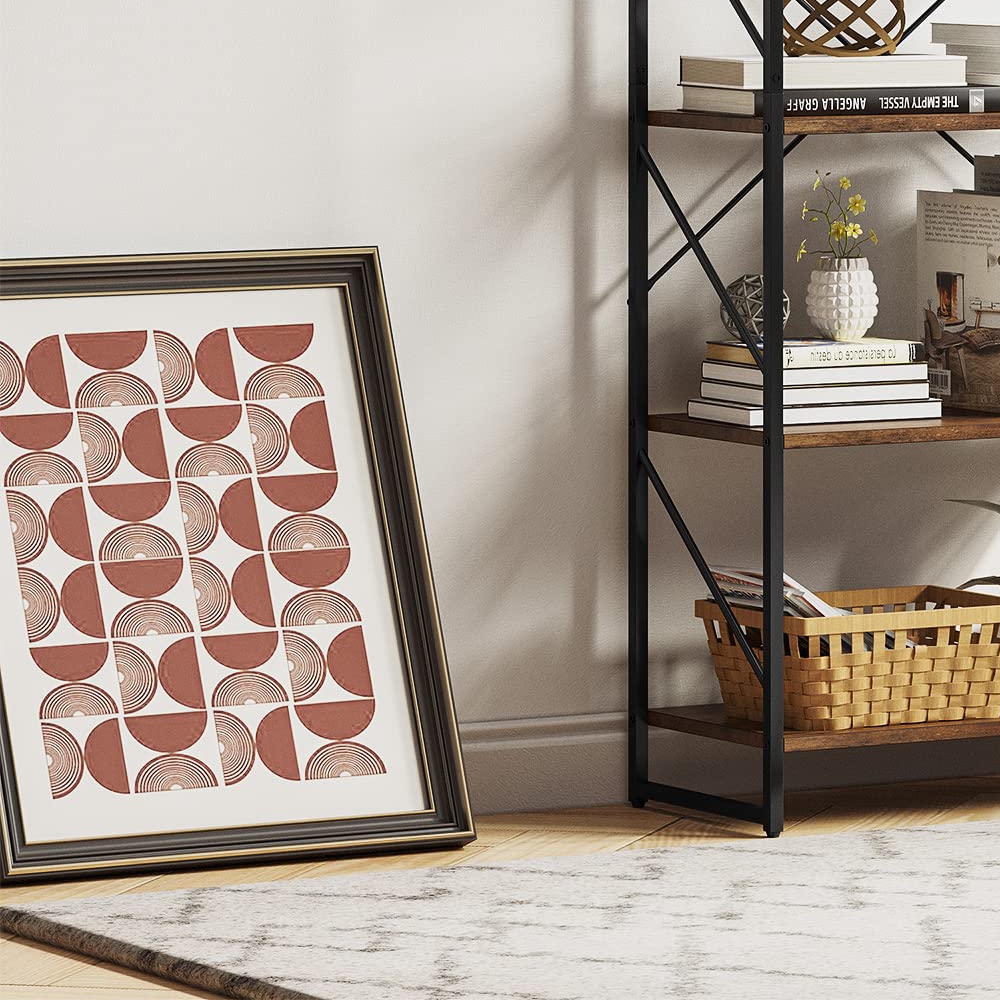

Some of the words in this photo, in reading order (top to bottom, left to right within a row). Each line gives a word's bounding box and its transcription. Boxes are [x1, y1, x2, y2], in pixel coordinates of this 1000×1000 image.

[786, 97, 819, 112] GRAFF
[821, 96, 867, 111] ANGELLA
[878, 96, 910, 111] VESSEL
[911, 95, 939, 109] EMPTY
[941, 95, 960, 109] THE
